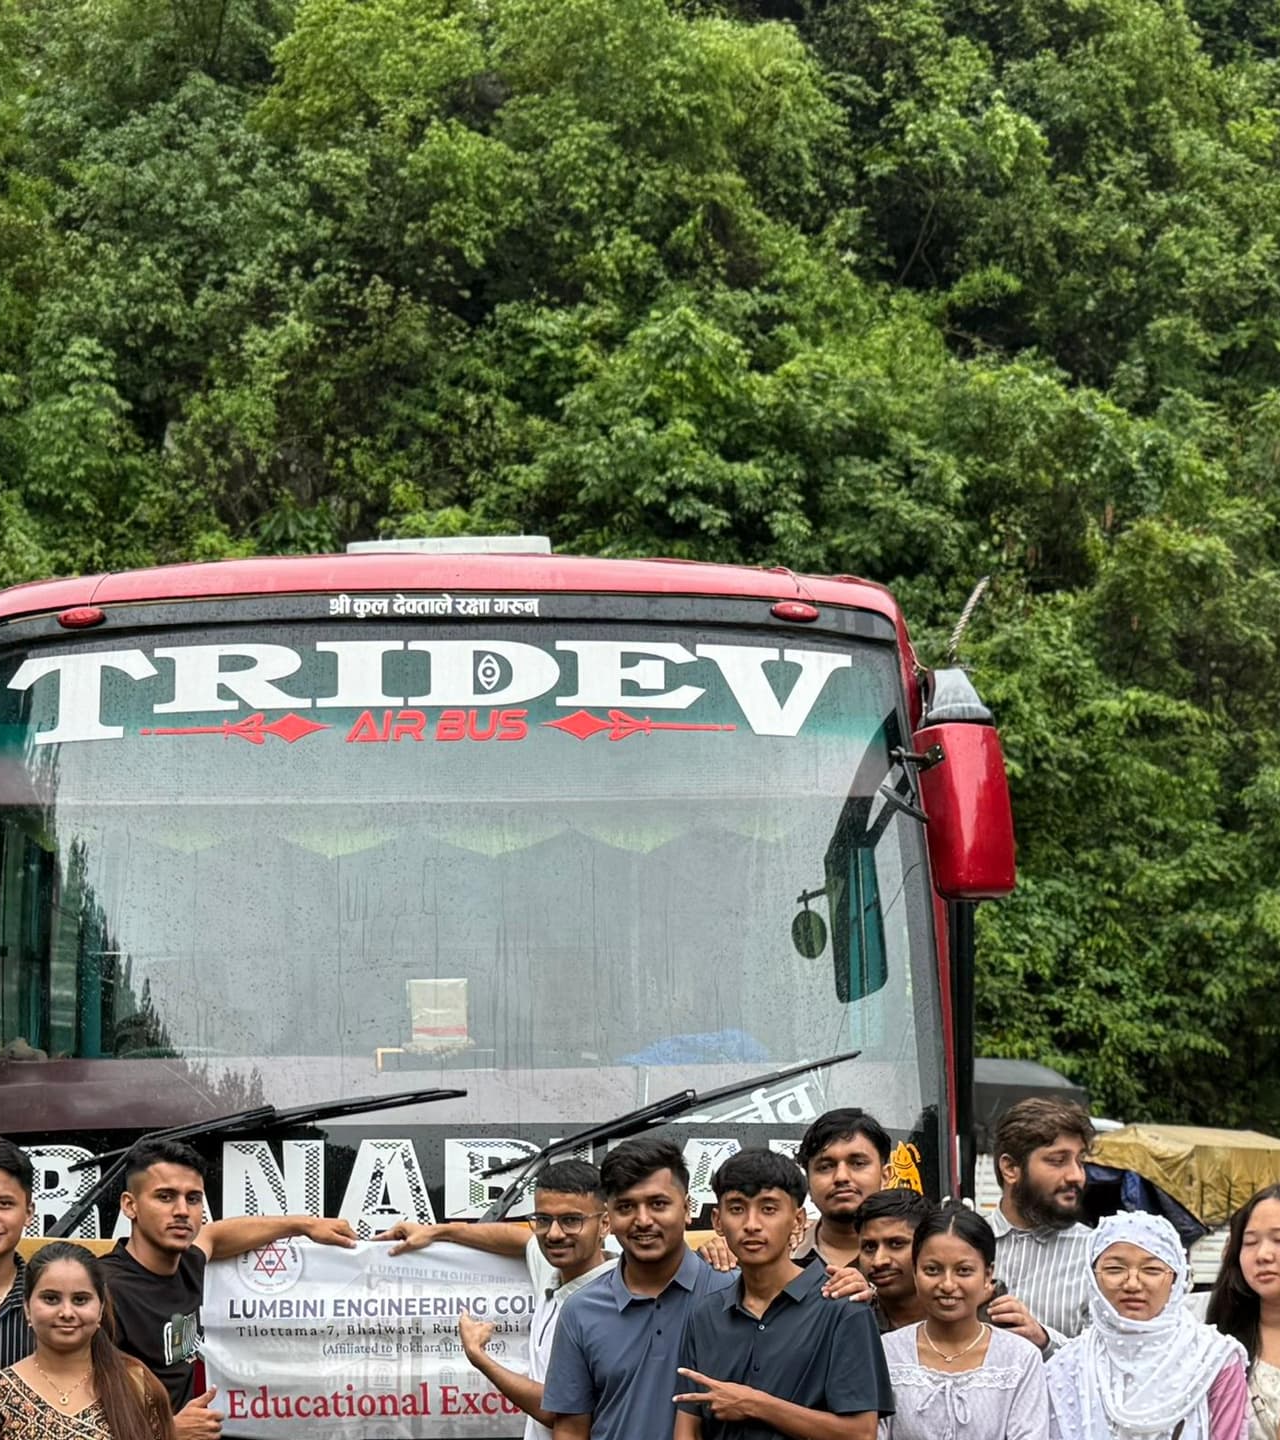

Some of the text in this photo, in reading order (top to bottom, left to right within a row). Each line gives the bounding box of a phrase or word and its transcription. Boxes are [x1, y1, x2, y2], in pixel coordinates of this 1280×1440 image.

[329, 594, 352, 616] श्री
[353, 598, 390, 618] कुल
[393, 594, 452, 616] देवताले
[455, 598, 491, 616] रक्षा
[7, 640, 852, 745] TRIDEV
[345, 709, 528, 743] AIR BUS
[229, 1299, 325, 1319] LUMBINI
[333, 1296, 488, 1318] ENGINEERING
[236, 1324, 340, 1338] Tilottama-7,
[433, 1320, 520, 1337] Rupehi
[323, 1342, 379, 1357] (Affiliated
[381, 1344, 393, 1354] to
[396, 1342, 441, 1354] Pokhara
[228, 1383, 432, 1420] Educational
